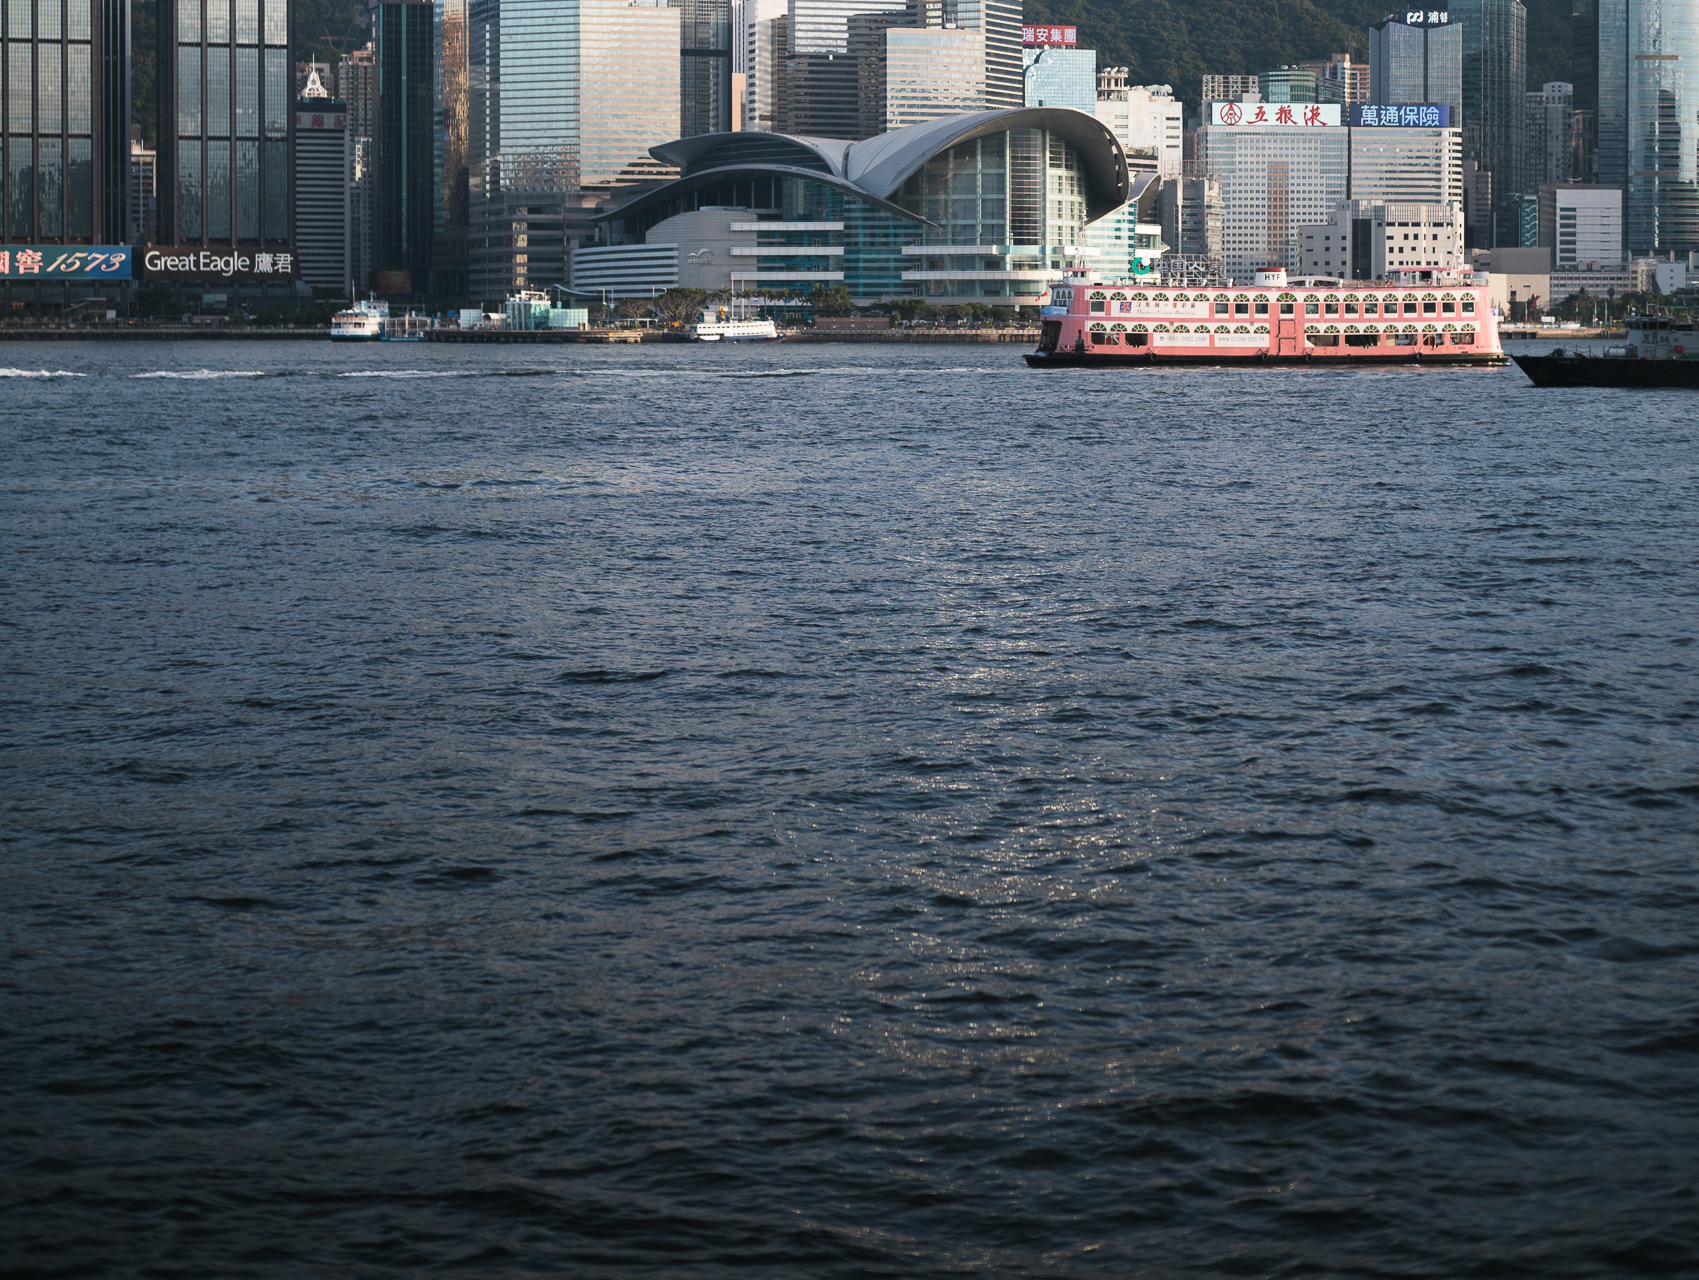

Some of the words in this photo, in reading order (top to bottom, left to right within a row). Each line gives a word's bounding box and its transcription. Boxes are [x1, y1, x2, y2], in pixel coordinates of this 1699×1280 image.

[1022, 27, 1076, 43] 瑞安集團
[1246, 104, 1328, 126] 五粮液
[1360, 105, 1440, 126] 萬通保險
[46, 252, 126, 272] 1573
[145, 251, 197, 271] Great
[200, 251, 250, 276] Eagle
[254, 252, 293, 273] 鷹君
